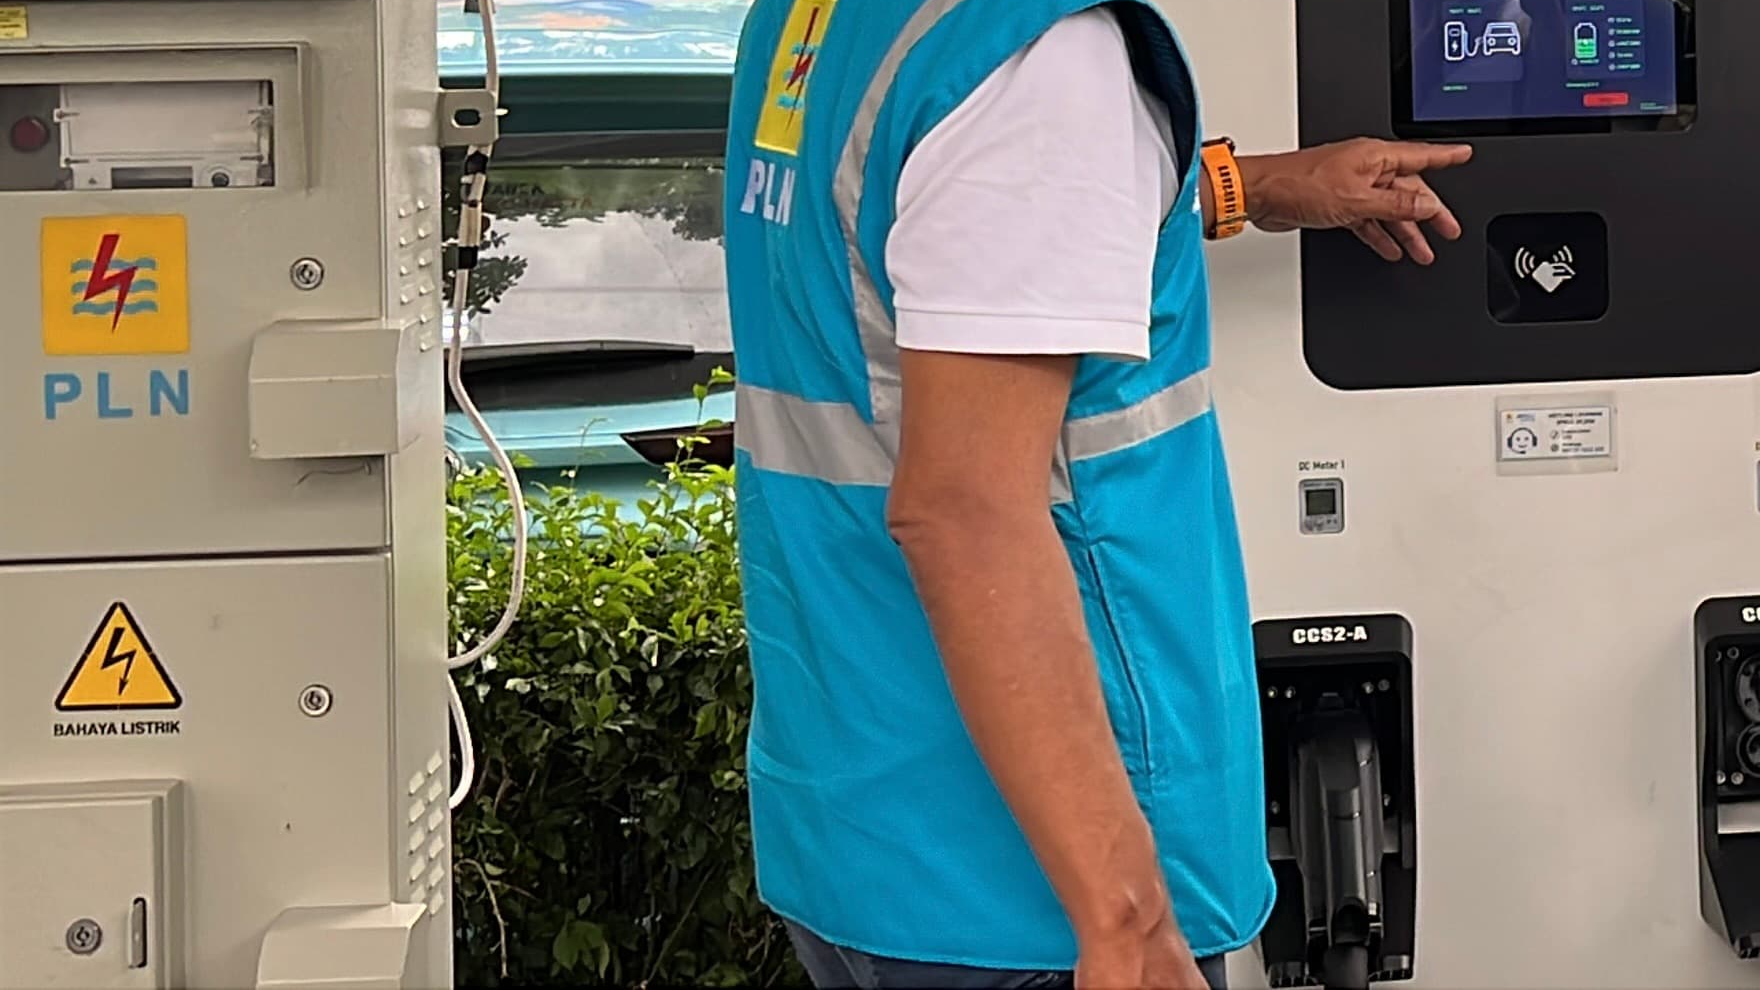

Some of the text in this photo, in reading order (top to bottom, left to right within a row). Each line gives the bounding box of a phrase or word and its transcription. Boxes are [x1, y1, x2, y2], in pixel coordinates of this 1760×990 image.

[740, 159, 796, 226] PLN
[44, 368, 190, 420] PLN
[1298, 461, 1310, 471] DC
[1292, 625, 1368, 644] CCS2-A
[53, 720, 181, 737] BAHAYA LISTRIK
